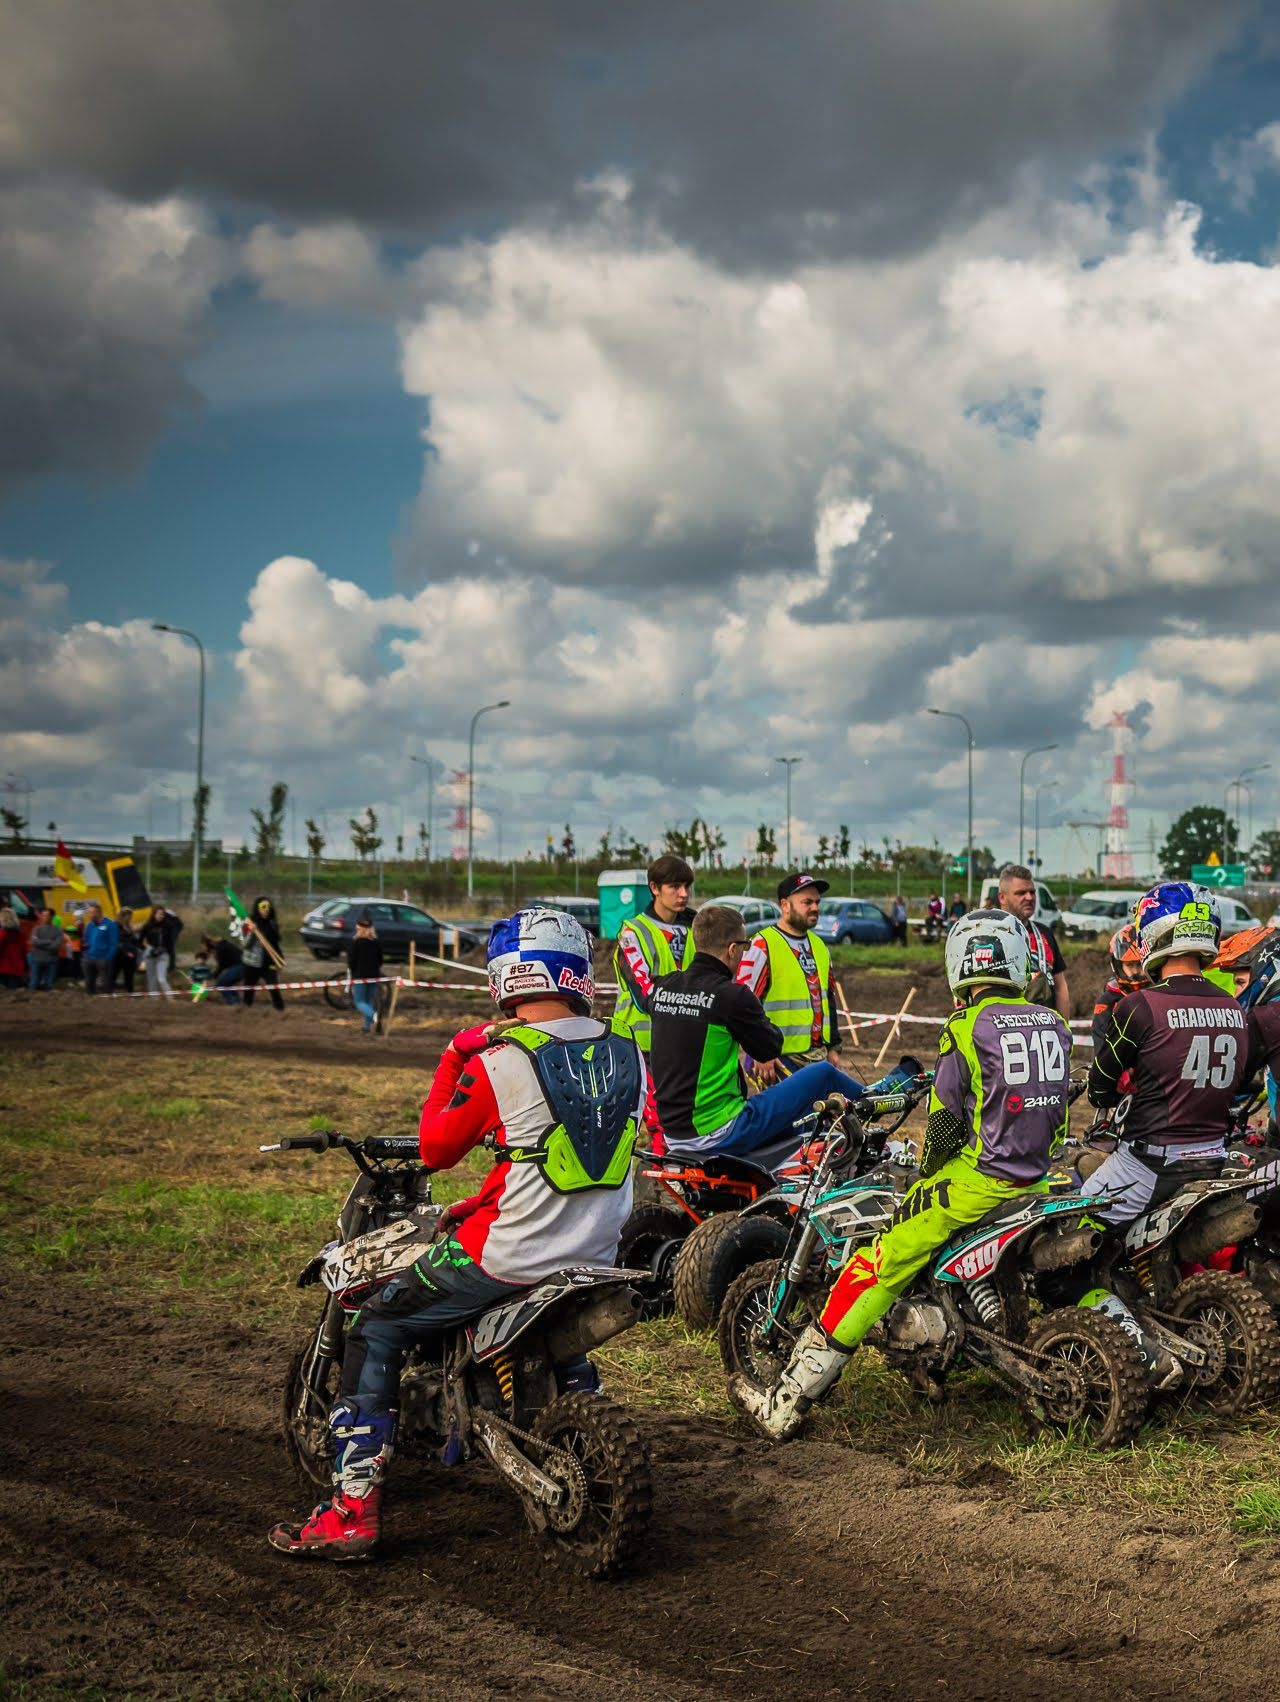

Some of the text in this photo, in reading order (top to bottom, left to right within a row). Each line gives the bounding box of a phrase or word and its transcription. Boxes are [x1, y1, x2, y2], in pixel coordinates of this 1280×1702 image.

[1180, 903, 1211, 921] 43
[510, 963, 534, 975] #87
[652, 987, 715, 1009] Kawasaki
[654, 1002, 700, 1017] Racing Team
[1167, 1008, 1244, 1029] GRABOWSKI
[1000, 1030, 1065, 1086] 810
[1181, 1034, 1238, 1089] 43
[1024, 1094, 1061, 1108] 24MX
[1125, 1206, 1173, 1251] 43
[961, 1238, 1001, 1280] 810
[474, 1300, 527, 1354] 87
